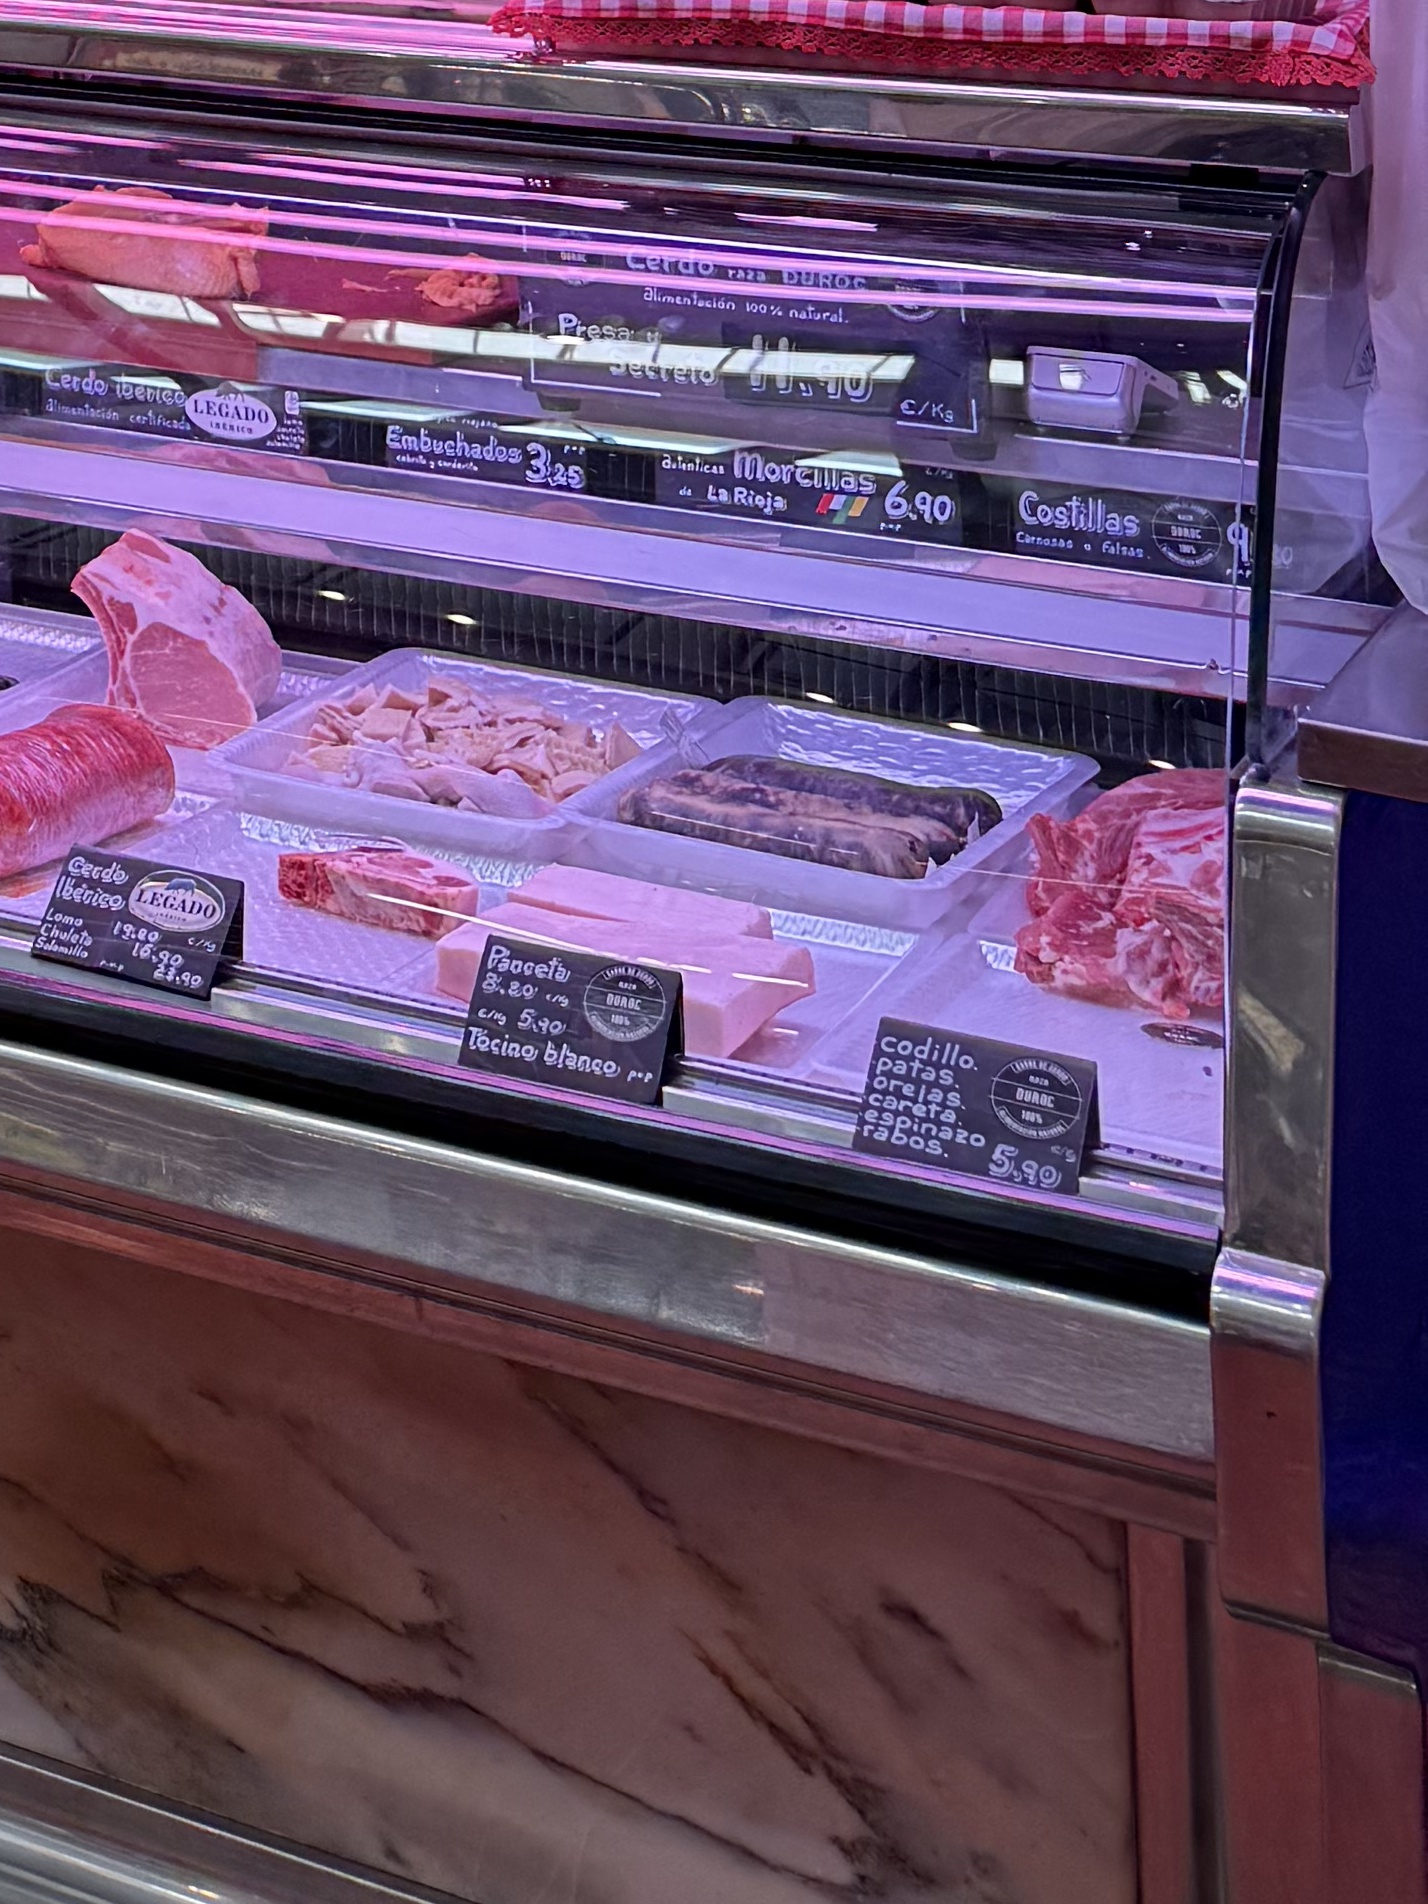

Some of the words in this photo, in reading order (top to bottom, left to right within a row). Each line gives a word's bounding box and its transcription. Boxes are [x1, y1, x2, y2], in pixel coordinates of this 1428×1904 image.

[626, 252, 716, 275] Cerdo
[782, 271, 867, 291] DUROC
[745, 301, 783, 316] 100%
[558, 313, 629, 343] Presa
[45, 369, 108, 396] Cerdo
[194, 398, 269, 424] LEGADO
[386, 425, 522, 463] Embuchados
[707, 485, 730, 504] La
[734, 487, 786, 515] Rioja
[1019, 491, 1140, 536] Costillas
[68, 856, 128, 884] Cerdo
[46, 908, 83, 926] Lomo
[136, 890, 216, 918] LEGADO
[488, 945, 570, 983] Panceta
[468, 1026, 538, 1060] Tocino
[544, 1041, 620, 1077] blanco
[880, 1037, 978, 1070] codillo.
[876, 1057, 959, 1088] patas.
[869, 1093, 962, 1125] careta.
[1016, 1087, 1054, 1108] DUROC
[863, 1125, 948, 1157] rabos.
[864, 1109, 985, 1147] espinazo
